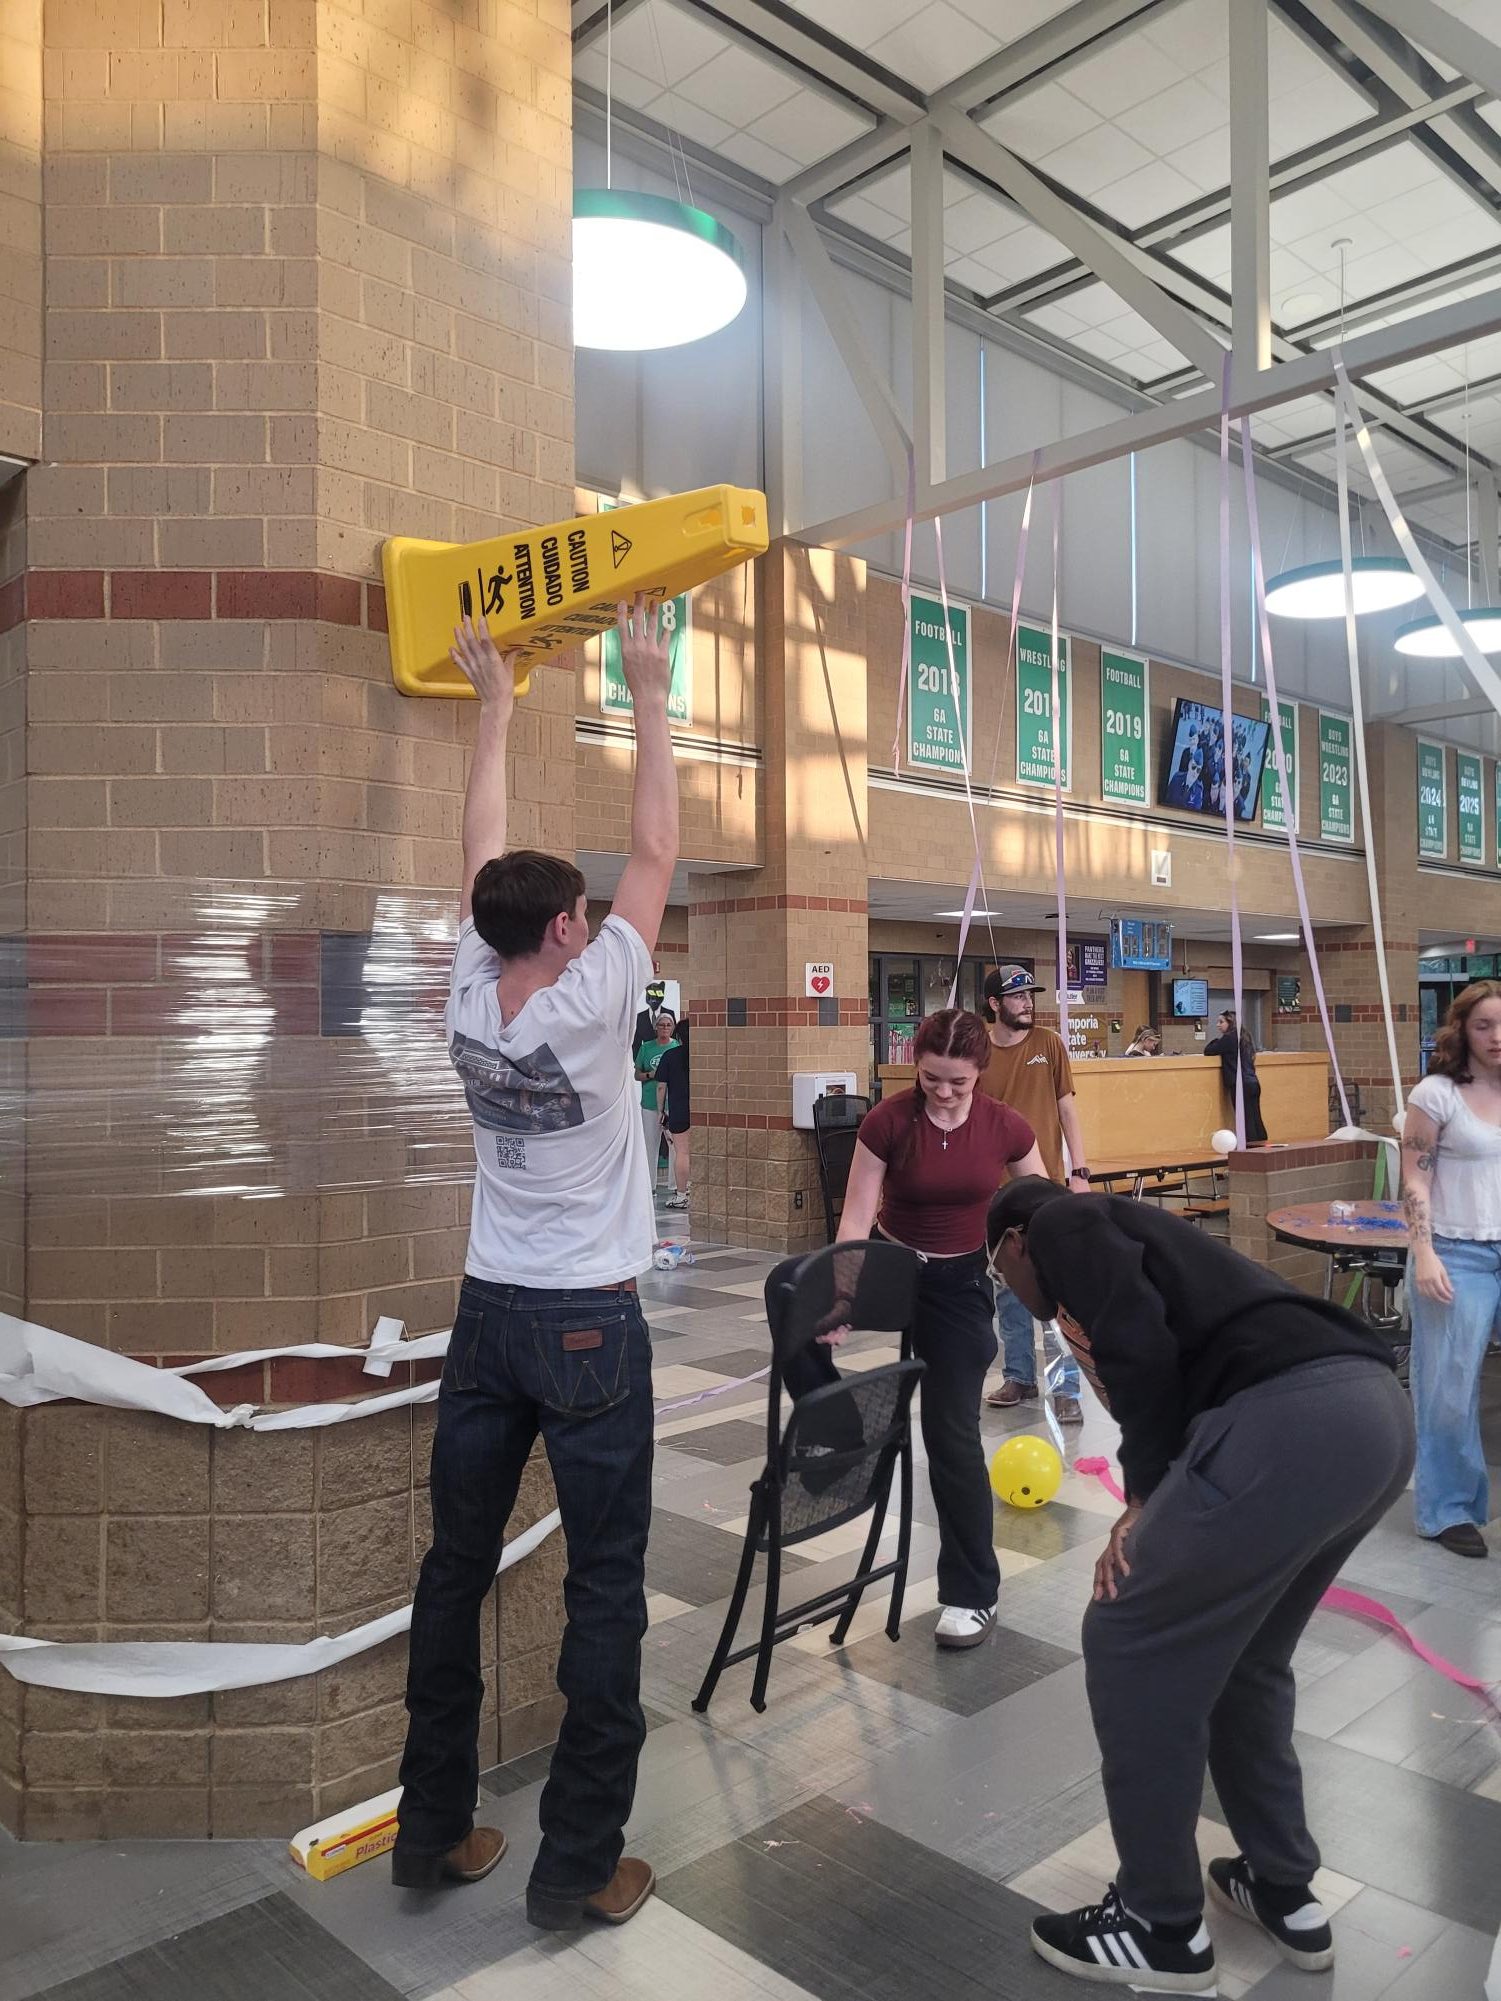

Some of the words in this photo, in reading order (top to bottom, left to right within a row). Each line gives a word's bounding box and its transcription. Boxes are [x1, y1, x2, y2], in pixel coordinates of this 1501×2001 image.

[541, 536, 563, 606] CUIDADO
[567, 530, 590, 593] CAUTION
[514, 544, 536, 620] ATTENTION
[915, 620, 962, 646] FOOTBLL
[1019, 647, 1066, 673] WRESTLG
[1106, 667, 1141, 689] FOOTBALL
[608, 682, 685, 712] CHANS
[933, 708, 946, 724] 6A
[1106, 709, 1142, 740] 2019
[926, 725, 953, 744] STATE
[1038, 729, 1049, 745] 6A
[1032, 746, 1056, 763] STATE
[1119, 748, 1129, 763] 6A
[1265, 749, 1293, 774] 200
[1020, 761, 1066, 782] CHAMPIOS
[1114, 764, 1135, 780] STATE
[1322, 761, 1348, 786] 2023
[1104, 778, 1145, 797] CHAMPIONS
[1420, 786, 1442, 807] 2024
[1328, 807, 1344, 820] STATE
[1459, 795, 1480, 815] 2025
[811, 965, 830, 974] AED
[1067, 1014, 1099, 1032] mporia
[356, 1832, 398, 1860] Plastic
